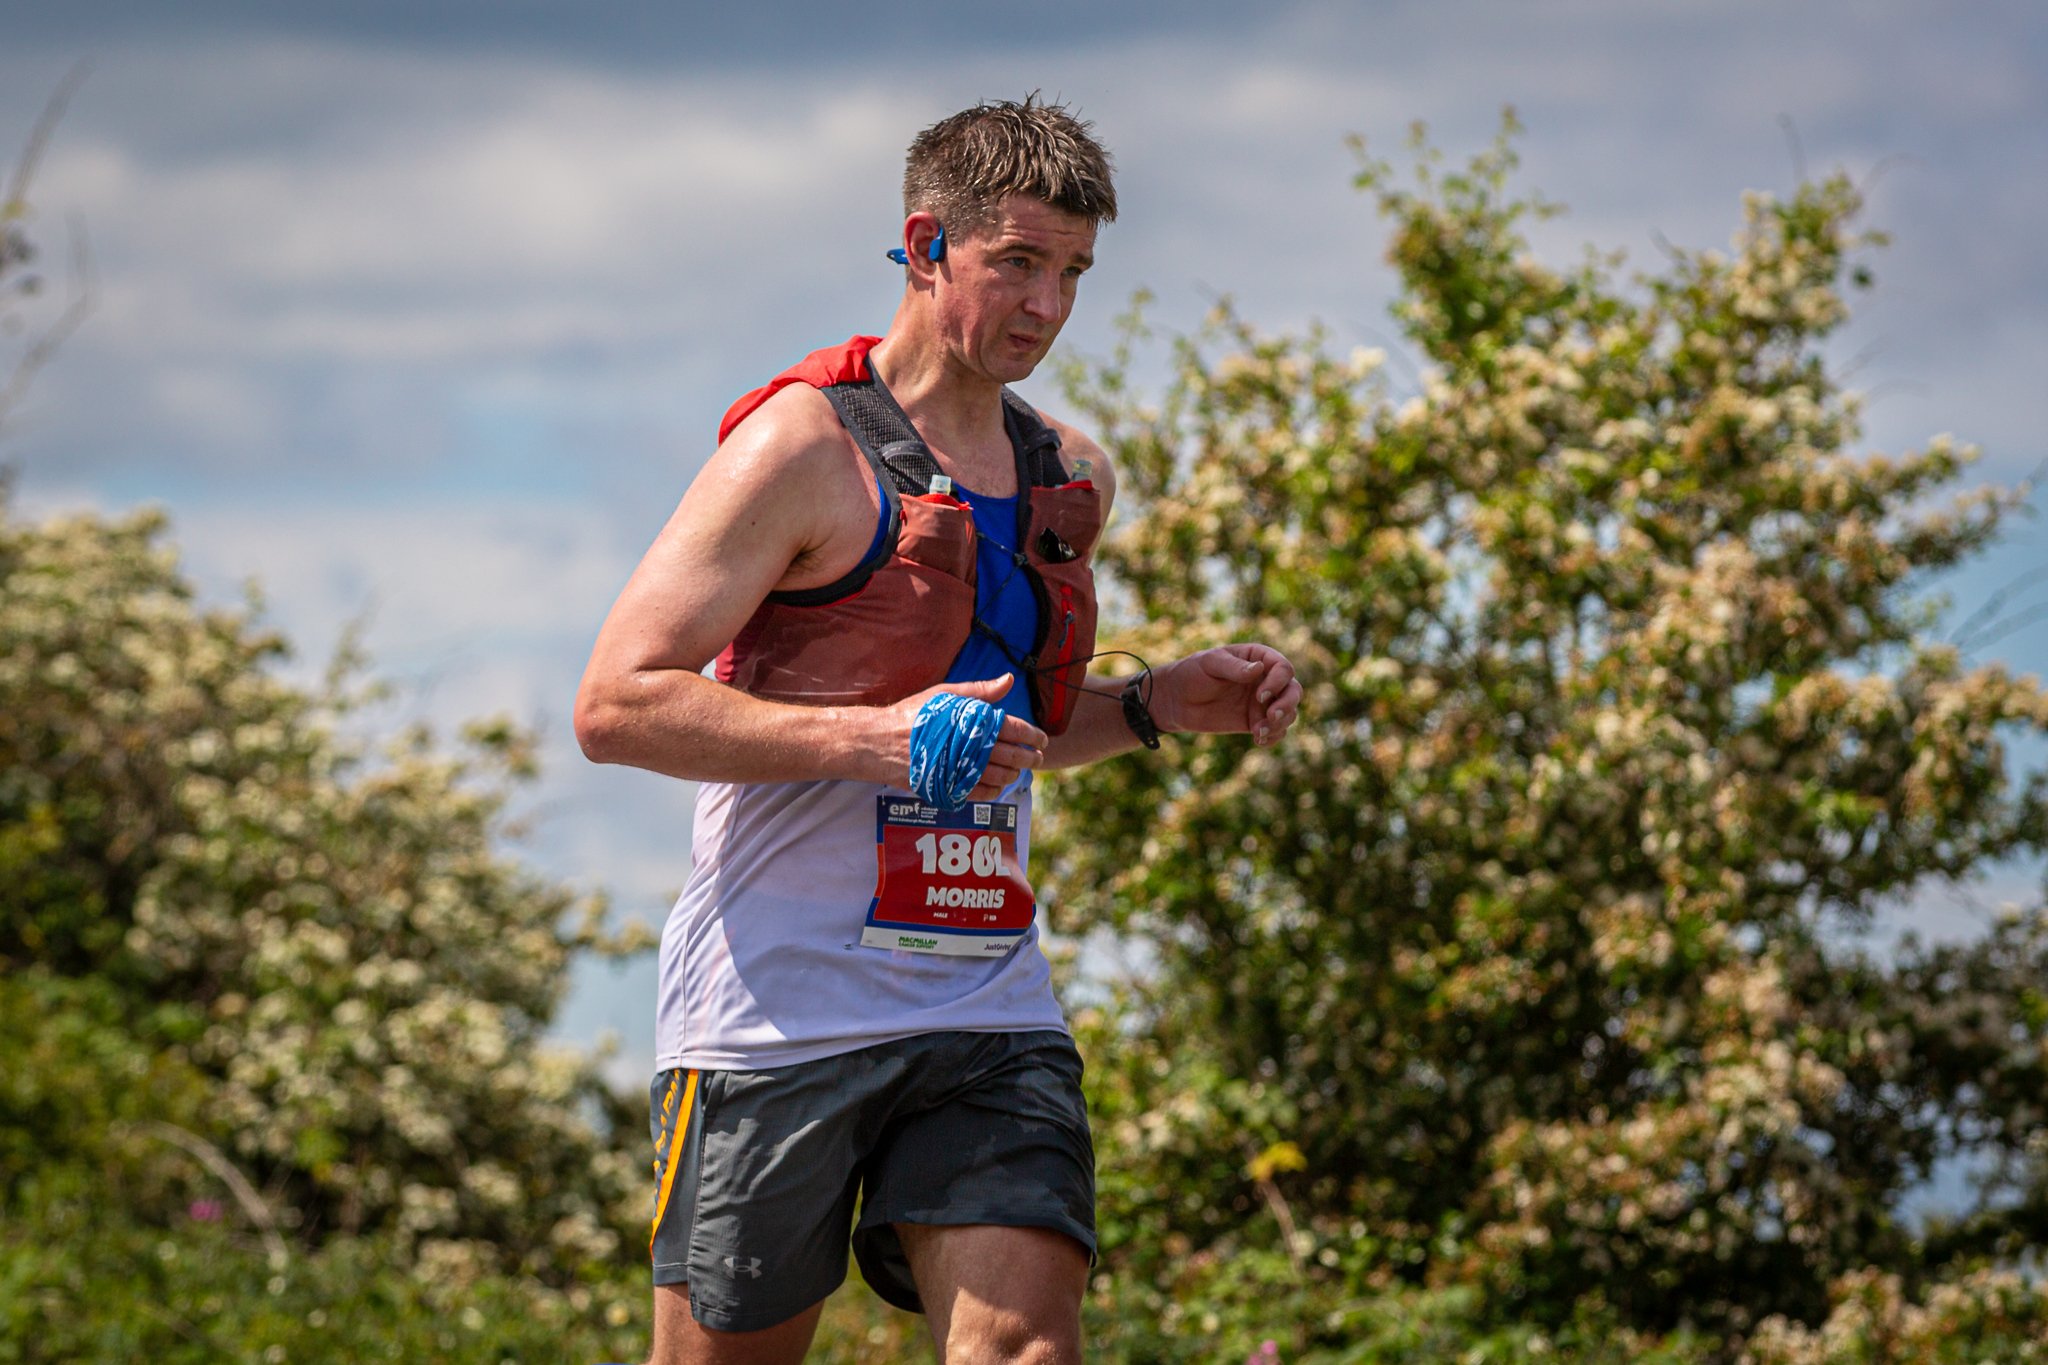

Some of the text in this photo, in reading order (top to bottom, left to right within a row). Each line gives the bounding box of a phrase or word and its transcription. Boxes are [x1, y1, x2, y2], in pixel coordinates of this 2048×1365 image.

[889, 802, 920, 816] emf
[926, 886, 1005, 909] MORRIS
[898, 936, 938, 946] MACMILLAN
